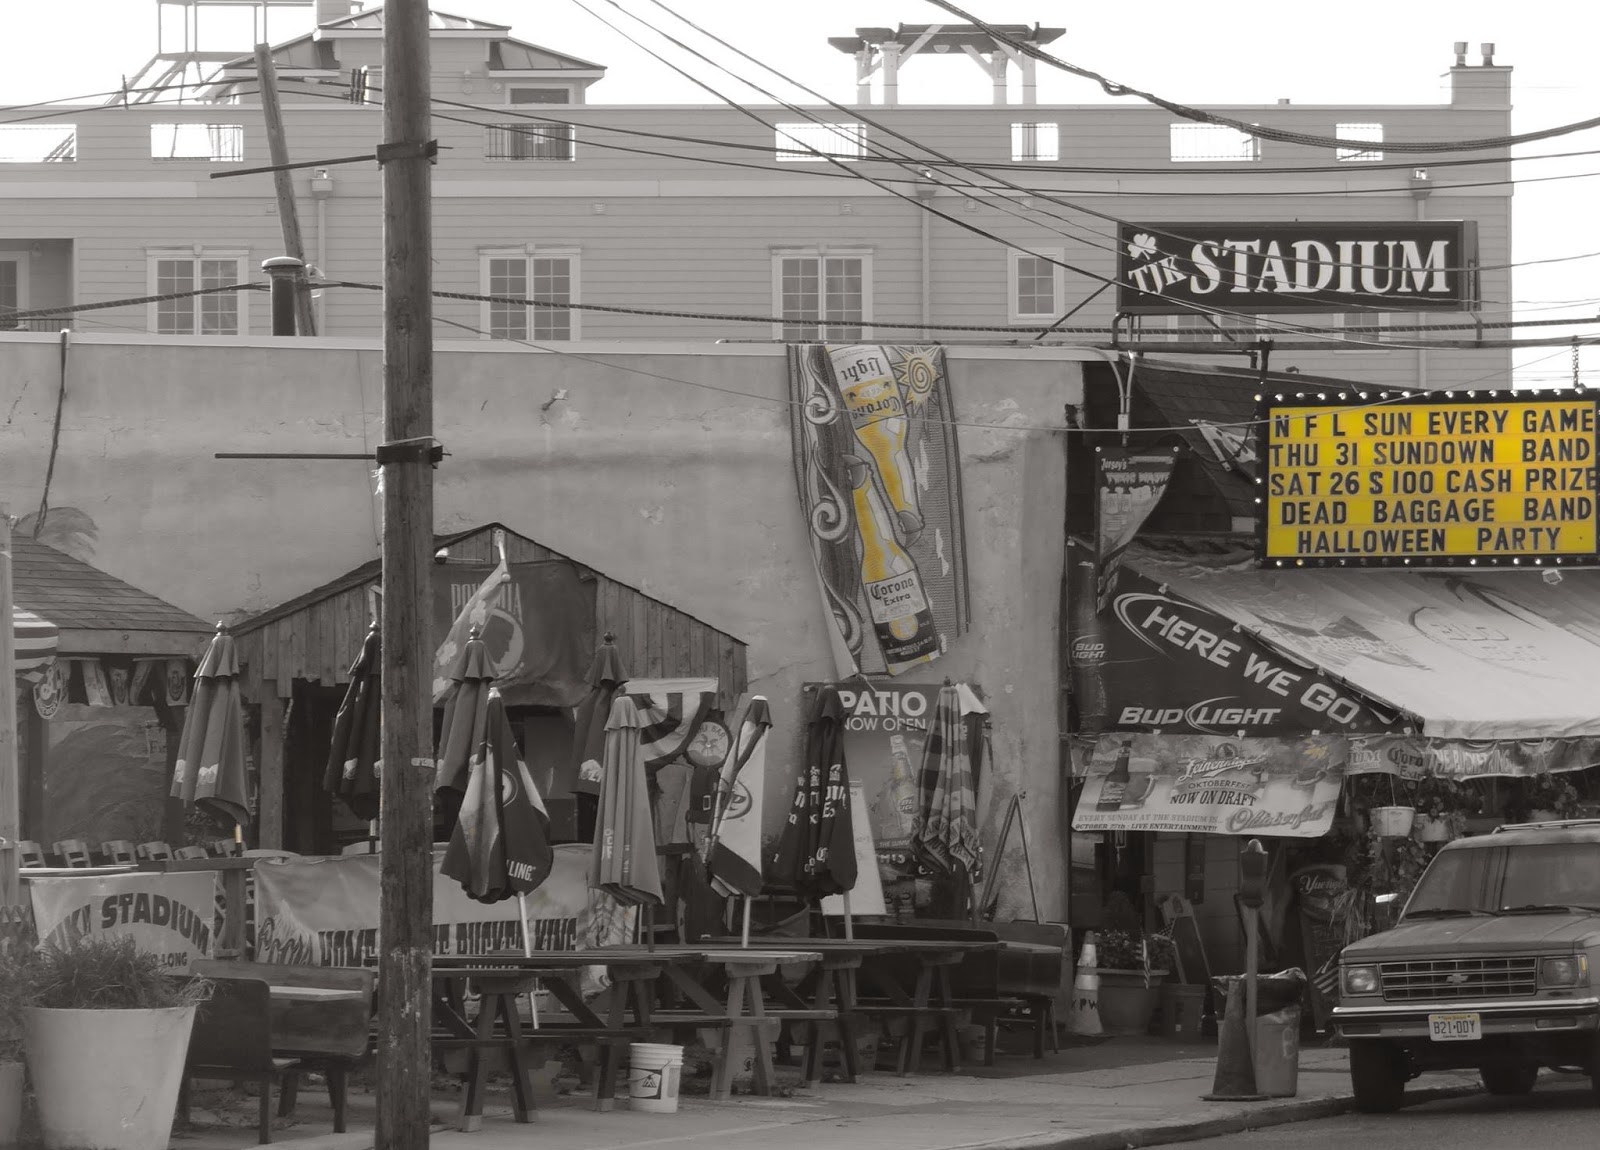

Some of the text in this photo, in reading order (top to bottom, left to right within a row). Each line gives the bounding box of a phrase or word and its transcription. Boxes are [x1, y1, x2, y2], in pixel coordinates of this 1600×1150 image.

[1128, 238, 1451, 296] TJK STADIUM
[1364, 412, 1412, 436] SUN
[1428, 409, 1509, 435] EVERY
[1523, 408, 1594, 433] GAME
[1270, 437, 1590, 467] THU 31 SUNDOWN BAND
[1271, 472, 1321, 496] SAT
[1330, 471, 1360, 495] 26
[1446, 468, 1512, 493] CASH
[1525, 467, 1597, 492] PRIZE
[1281, 496, 1592, 525] DEAD BAGGAGE BAND
[1298, 527, 1561, 553] HALLOWEEN PARTY
[870, 577, 915, 600] Corona
[884, 592, 911, 607] Extra
[1071, 651, 1106, 659] LIGHT
[1075, 643, 1105, 651] BUD
[1141, 605, 1360, 724] HERE WE GO
[838, 691, 928, 717] PATIO
[844, 717, 927, 732] NOW OPEN
[1196, 708, 1282, 725] LIGHT
[1187, 779, 1251, 790] OKTOBERFEST
[1169, 790, 1257, 806] NOW ON DRAFT
[1078, 814, 1105, 822] EVERY
[1106, 814, 1138, 822] SUNDAY
[1140, 814, 1151, 822] AT
[1153, 814, 1170, 822] THE
[1172, 815, 1207, 823] STADIUM
[101, 892, 210, 956] STADIUM
